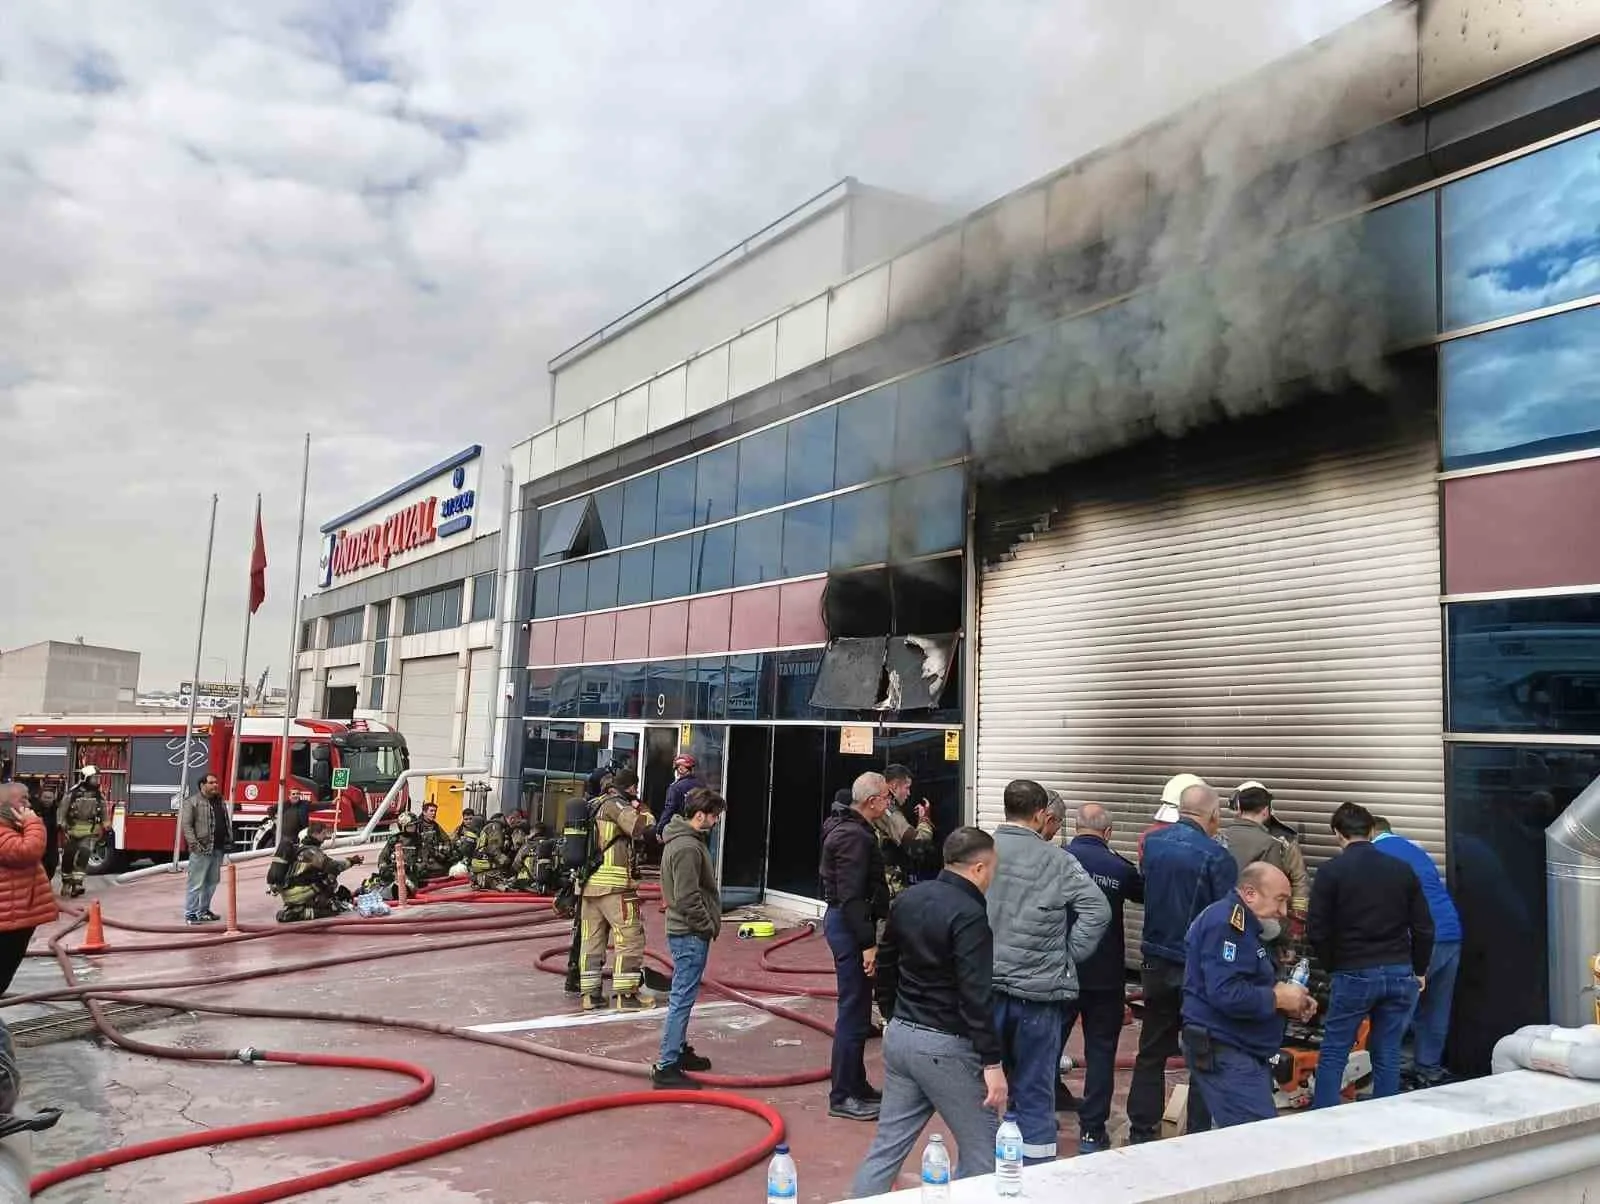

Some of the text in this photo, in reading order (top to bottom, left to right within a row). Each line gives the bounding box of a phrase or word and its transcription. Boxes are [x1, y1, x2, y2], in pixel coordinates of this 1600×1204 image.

[333, 524, 382, 577] ÖNDER
[380, 496, 438, 569] ÇUVAL
[656, 692, 666, 716] 9
